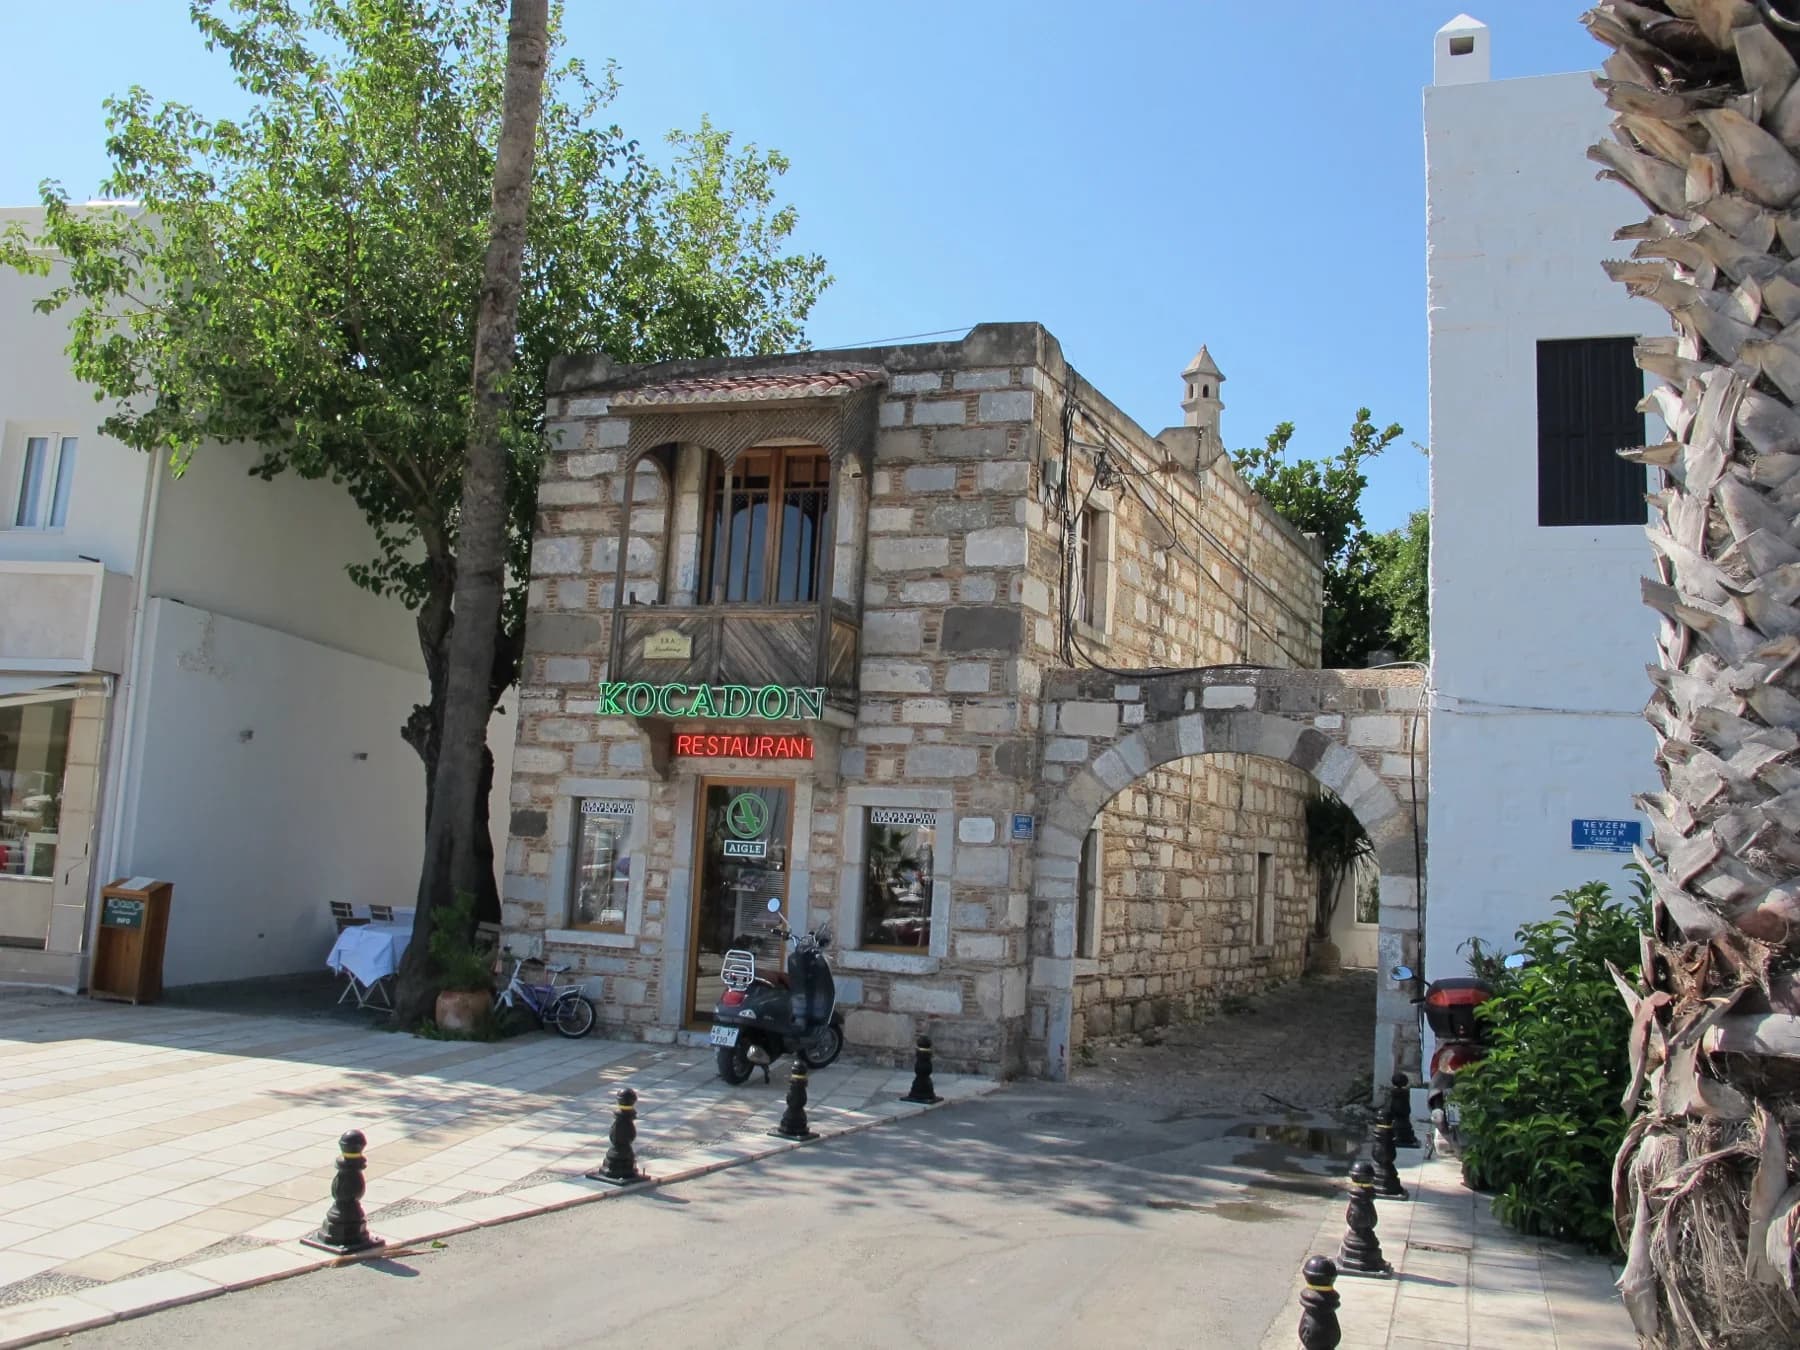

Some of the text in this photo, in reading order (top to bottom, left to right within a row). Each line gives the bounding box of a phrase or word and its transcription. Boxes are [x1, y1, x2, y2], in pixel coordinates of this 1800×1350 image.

[596, 682, 825, 720] KOCADON
[677, 735, 814, 759] RESTAURANT
[1582, 821, 1627, 829] NEYZEN
[729, 844, 762, 854] AIGLE
